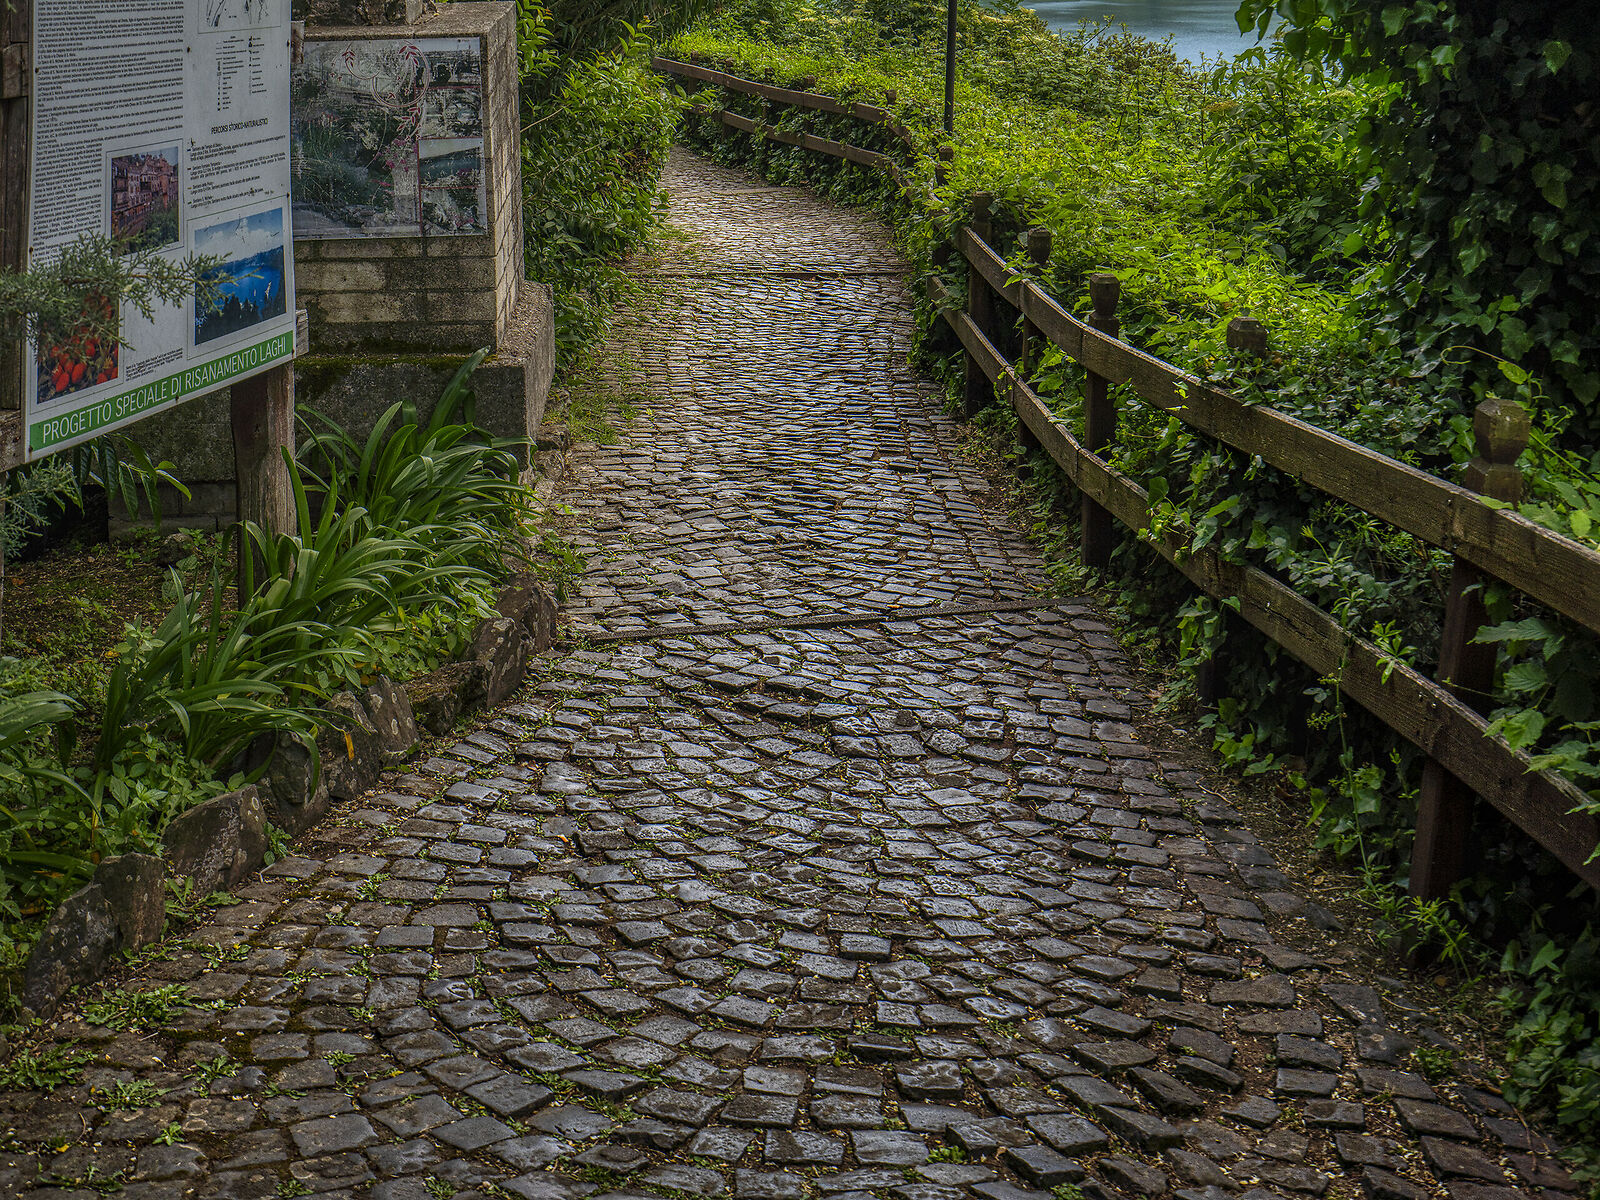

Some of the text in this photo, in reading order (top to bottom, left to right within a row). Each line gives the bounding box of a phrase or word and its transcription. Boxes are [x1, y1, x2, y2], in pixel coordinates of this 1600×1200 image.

[43, 403, 112, 444] PROGETTO
[115, 382, 168, 417] SPECIALE
[170, 376, 183, 395] DI
[185, 348, 258, 390] RISANAMENTO
[259, 336, 286, 362] LAGHI
